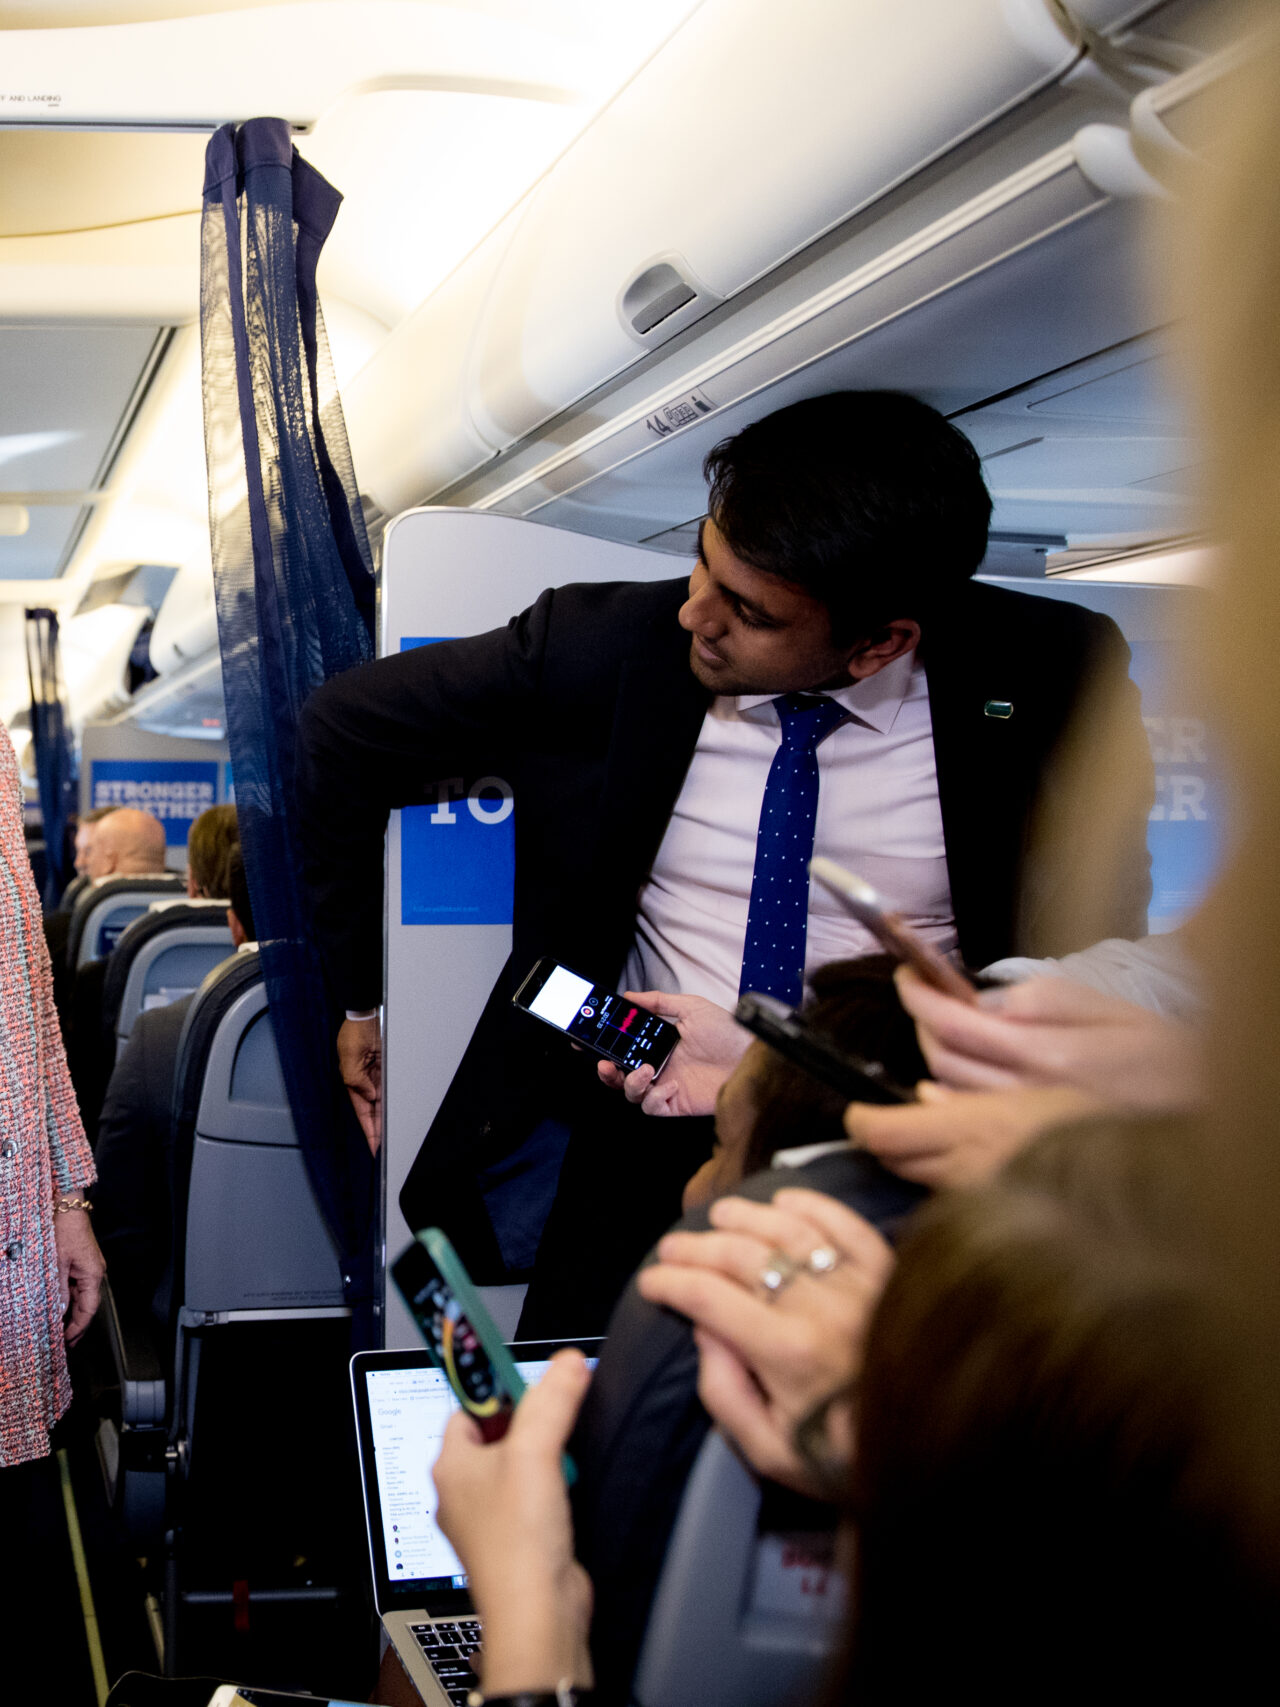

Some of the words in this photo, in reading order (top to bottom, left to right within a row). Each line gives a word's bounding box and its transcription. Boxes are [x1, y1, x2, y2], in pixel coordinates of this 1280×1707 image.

[9, 94, 26, 102] AND
[27, 94, 62, 102] LANDING
[646, 415, 674, 437] 14
[94, 780, 215, 800] STRONGER
[424, 775, 515, 825] TO
[377, 1407, 401, 1416] Google
